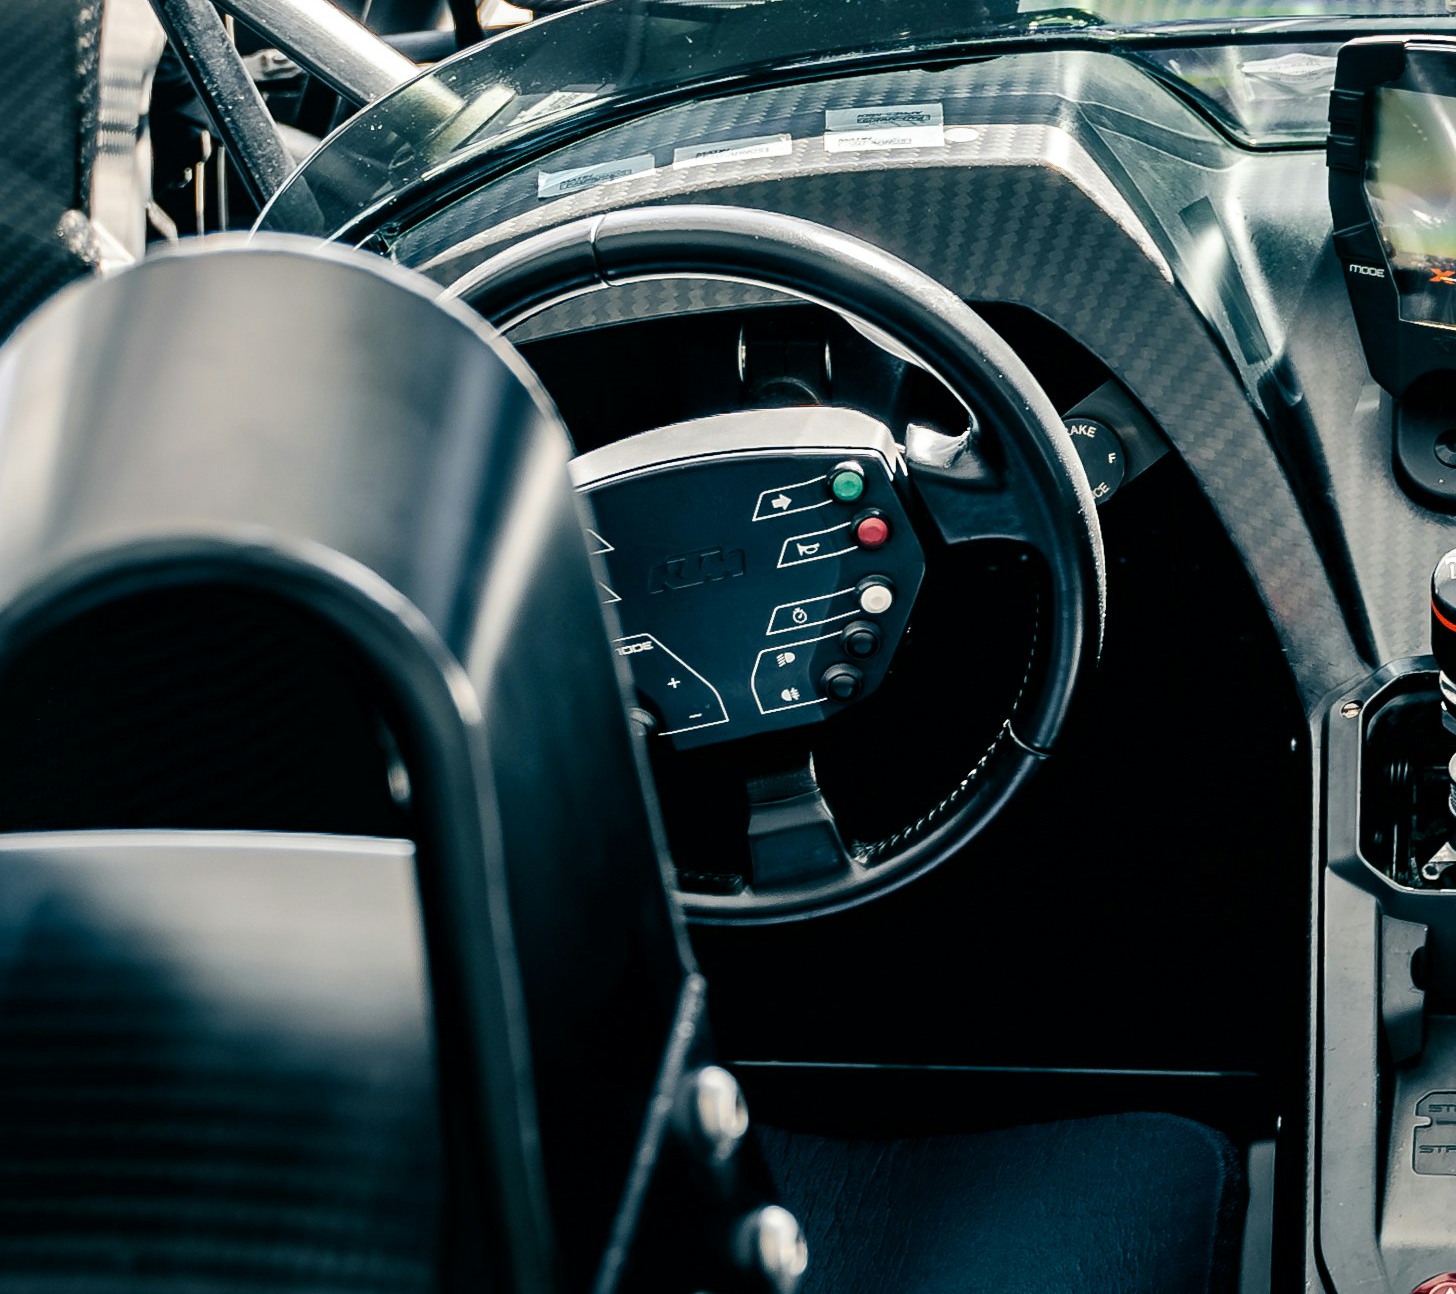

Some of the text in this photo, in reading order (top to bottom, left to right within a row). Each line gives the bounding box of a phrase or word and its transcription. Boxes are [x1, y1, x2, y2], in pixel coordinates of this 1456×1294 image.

[1349, 263, 1385, 278] MODE
[1068, 424, 1097, 438] AKE
[1108, 452, 1117, 464] F
[648, 546, 746, 595] KTM
